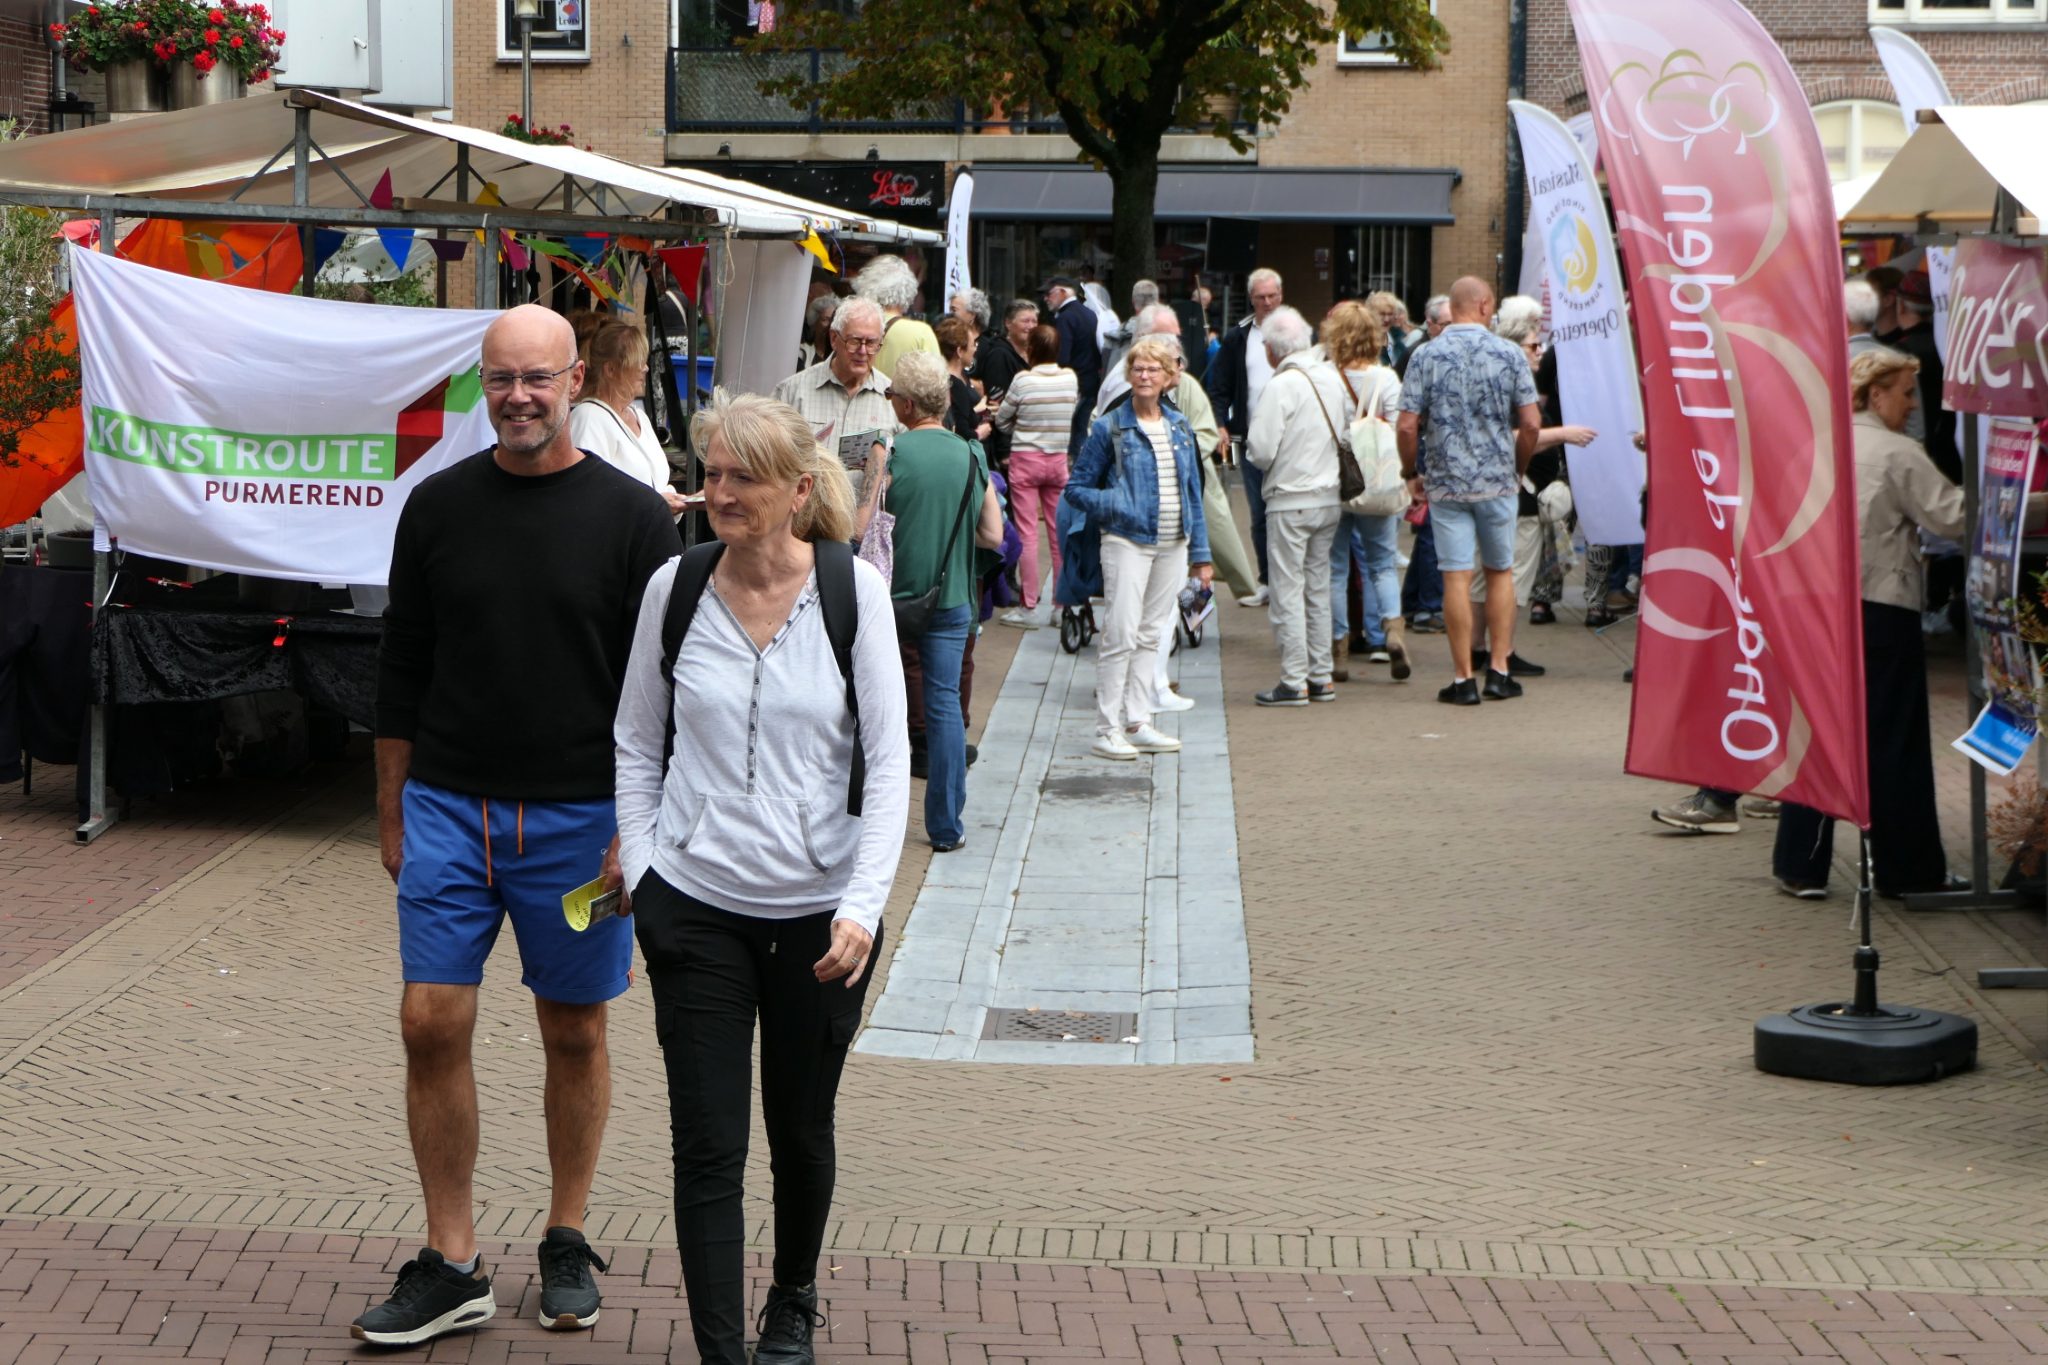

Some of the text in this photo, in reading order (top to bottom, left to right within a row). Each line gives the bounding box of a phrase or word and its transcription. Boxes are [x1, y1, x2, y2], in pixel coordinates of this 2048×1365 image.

[900, 197, 932, 206] DREAMS
[97, 414, 385, 474] KUNSTROUTE
[205, 480, 384, 507] PURMEREND
